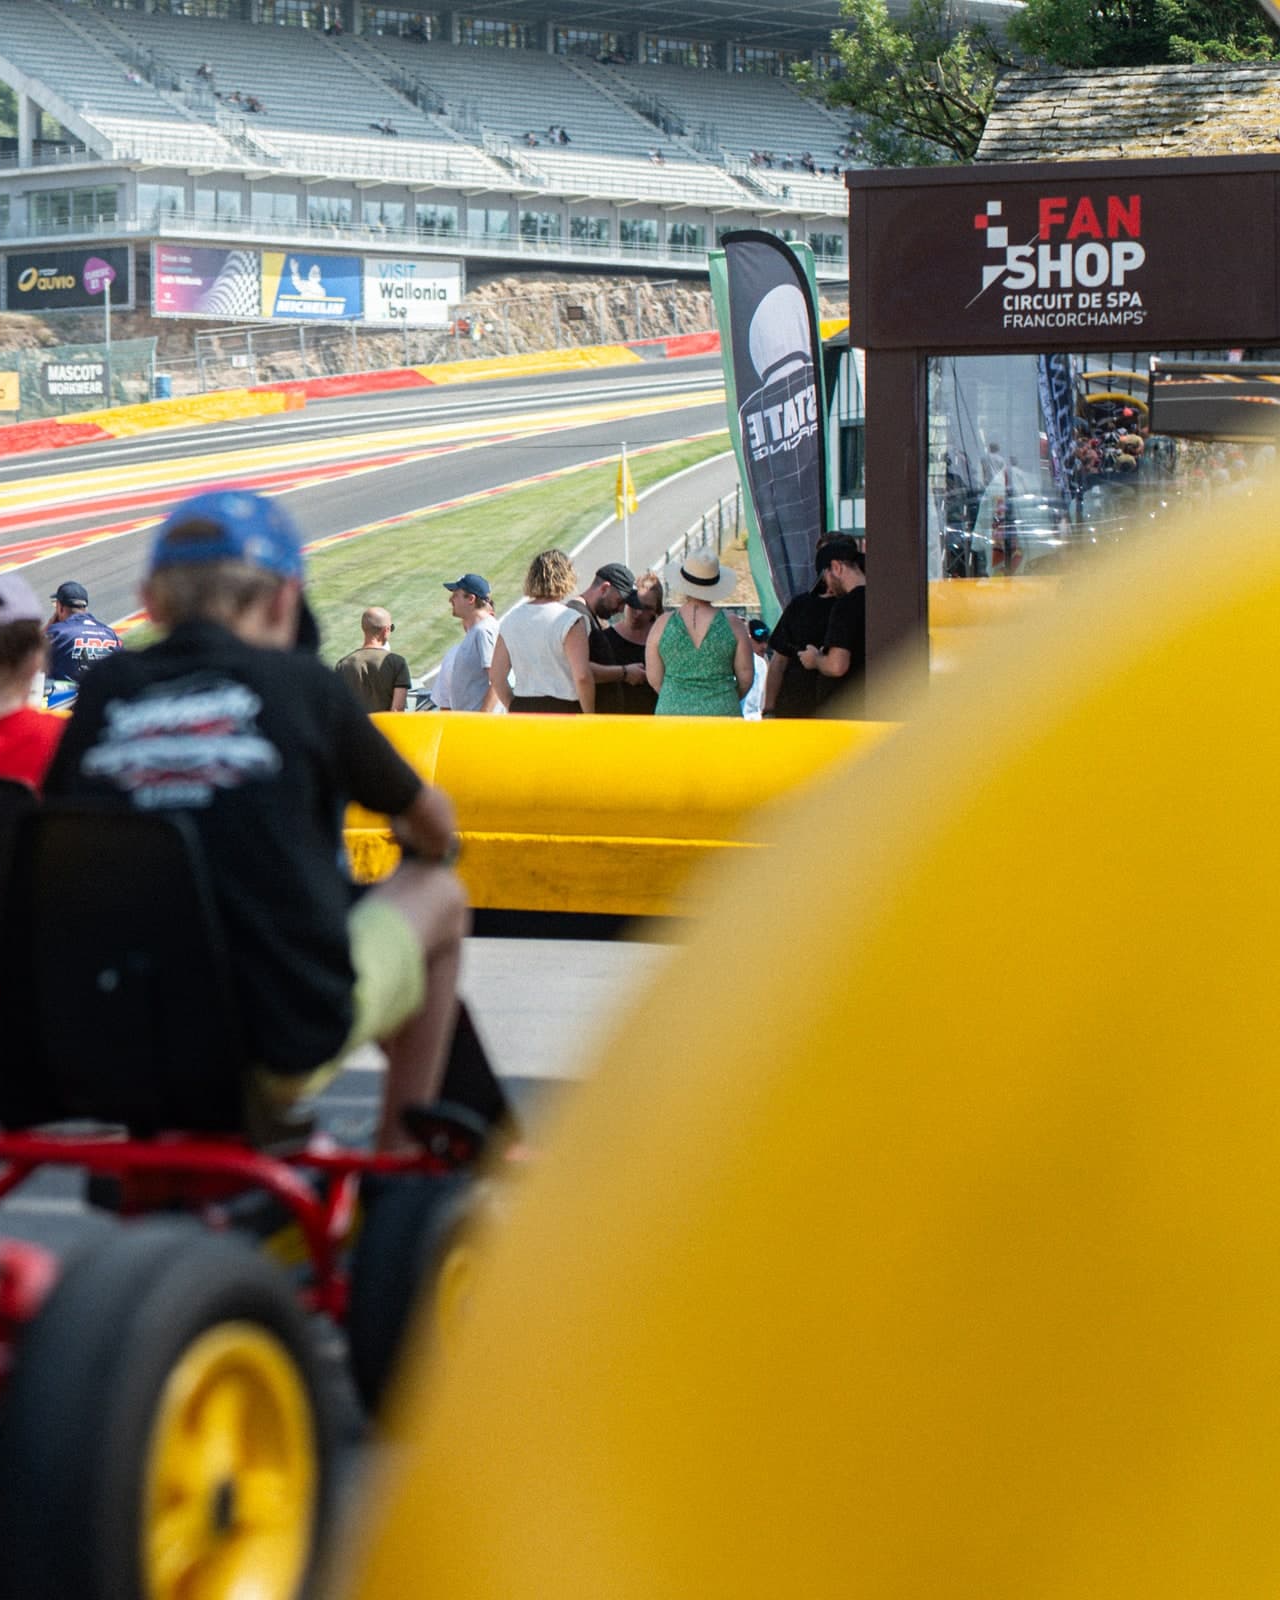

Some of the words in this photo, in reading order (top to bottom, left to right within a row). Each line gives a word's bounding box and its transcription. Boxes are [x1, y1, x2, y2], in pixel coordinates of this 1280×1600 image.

[1038, 195, 1142, 240] FAN
[378, 263, 417, 280] VISIT
[1002, 241, 1146, 290] SHOP
[379, 281, 447, 300] Wallonia
[1003, 293, 1073, 311] CIRCUIT
[1078, 292, 1102, 308] DE
[1107, 291, 1143, 308] SPA
[47, 381, 104, 395] WORKWEAR
